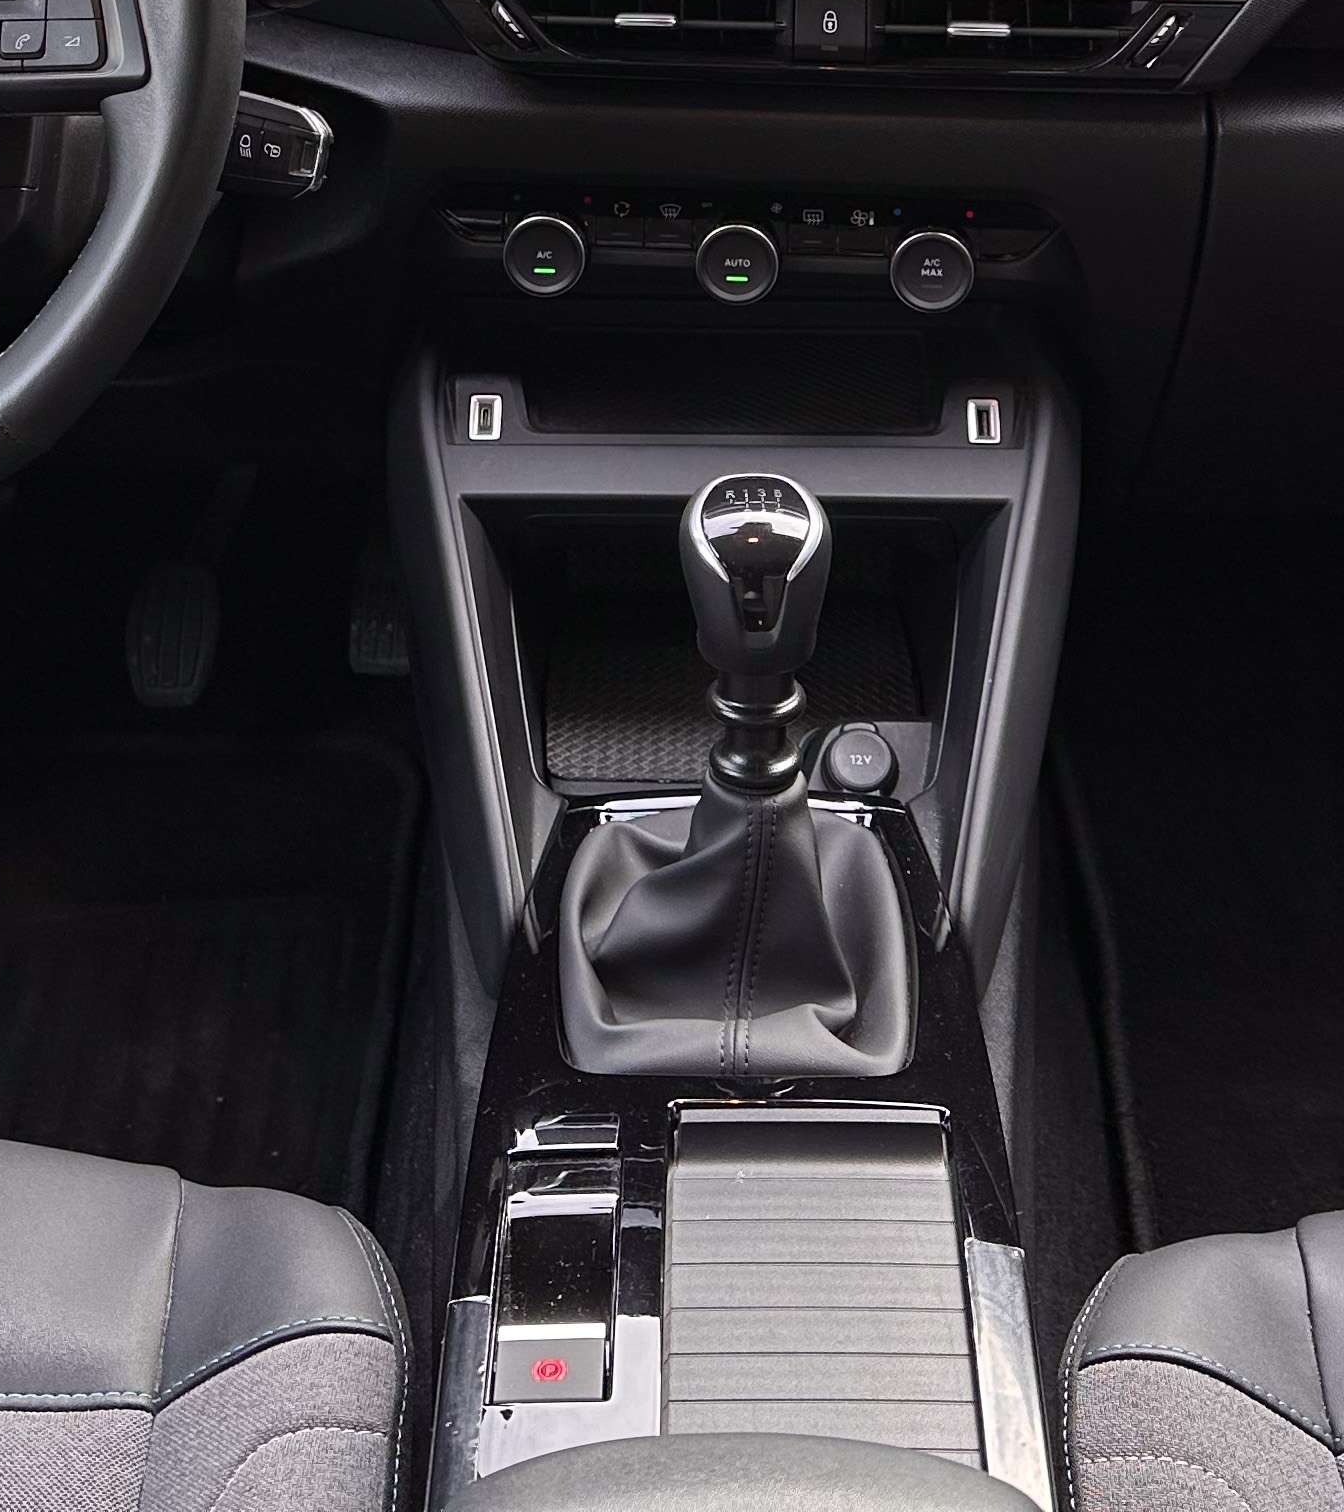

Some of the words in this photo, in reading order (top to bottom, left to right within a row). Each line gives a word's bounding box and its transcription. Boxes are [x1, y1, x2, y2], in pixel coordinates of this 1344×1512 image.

[536, 250, 552, 259] A/C
[724, 258, 751, 268] AUTO
[924, 258, 941, 267] A/C
[921, 268, 943, 277] MAX
[850, 754, 872, 765] 12V
